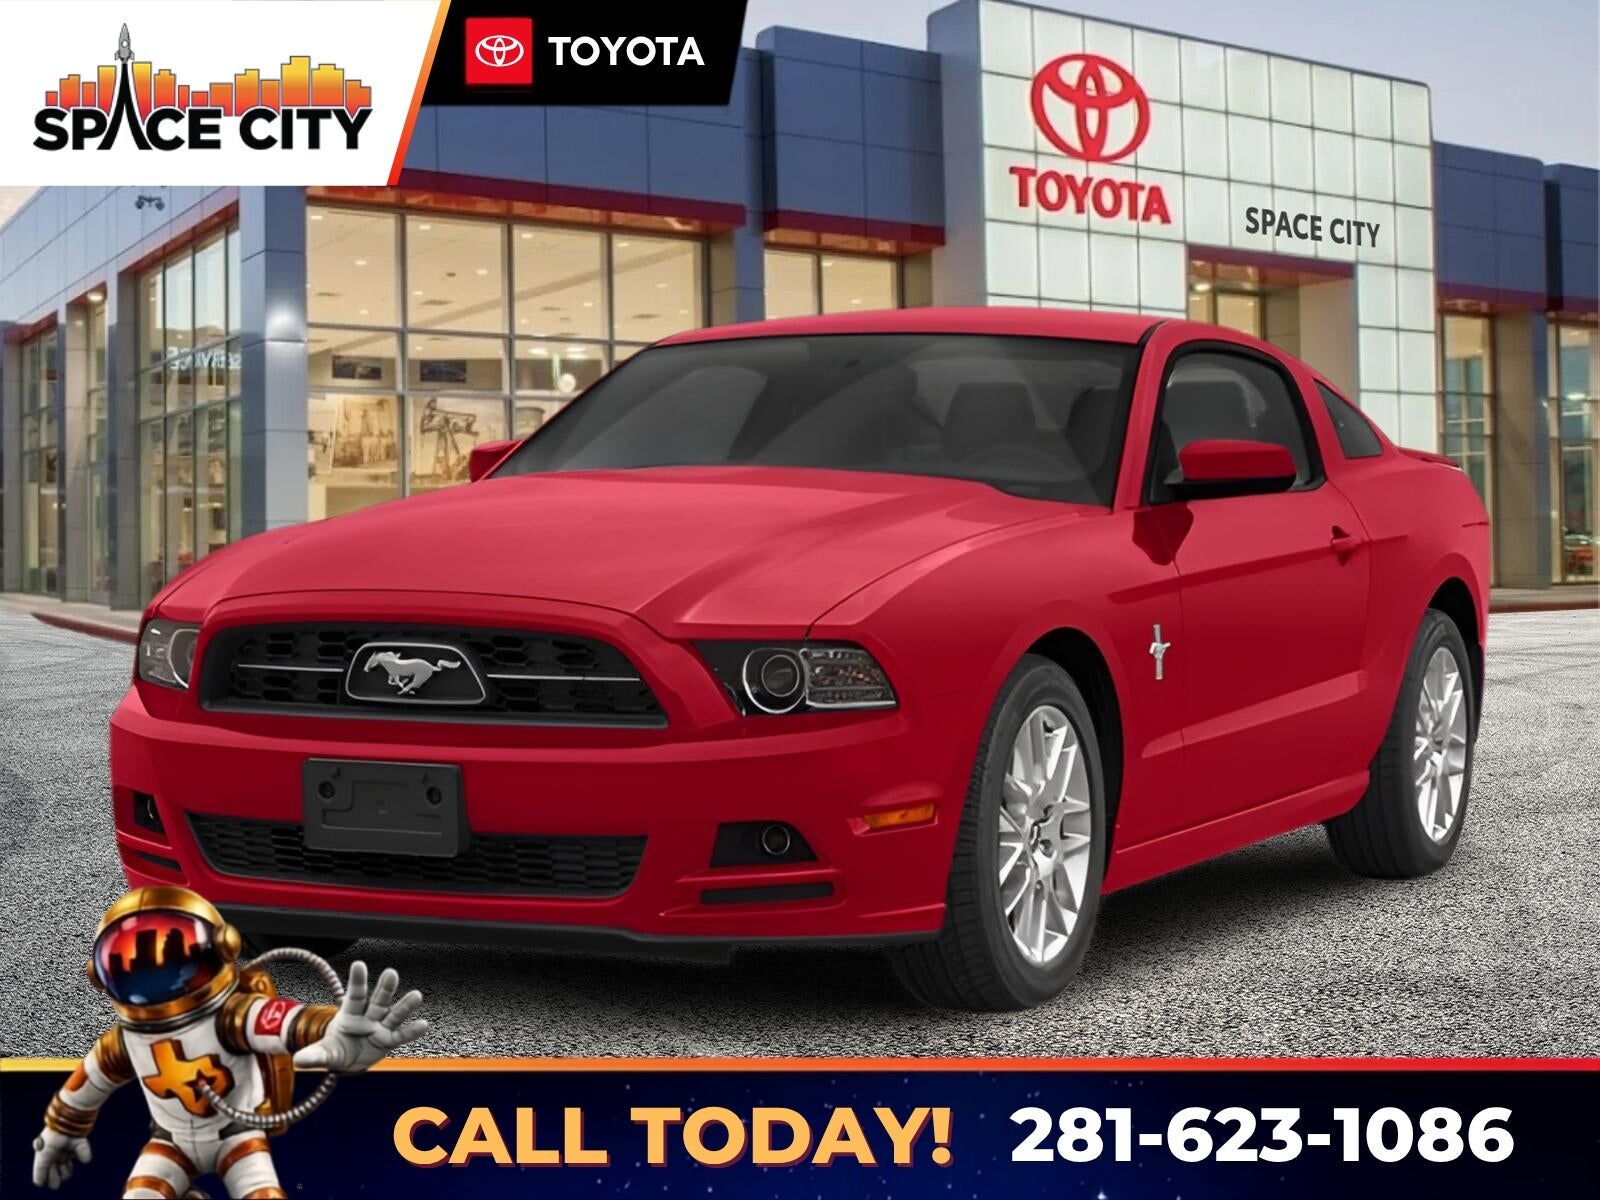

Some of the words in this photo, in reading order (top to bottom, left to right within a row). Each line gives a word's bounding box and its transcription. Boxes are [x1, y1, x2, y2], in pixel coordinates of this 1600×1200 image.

[1010, 166, 1171, 224] TOYOTA
[1245, 206, 1323, 242] SPACE
[1329, 217, 1381, 249] CITY
